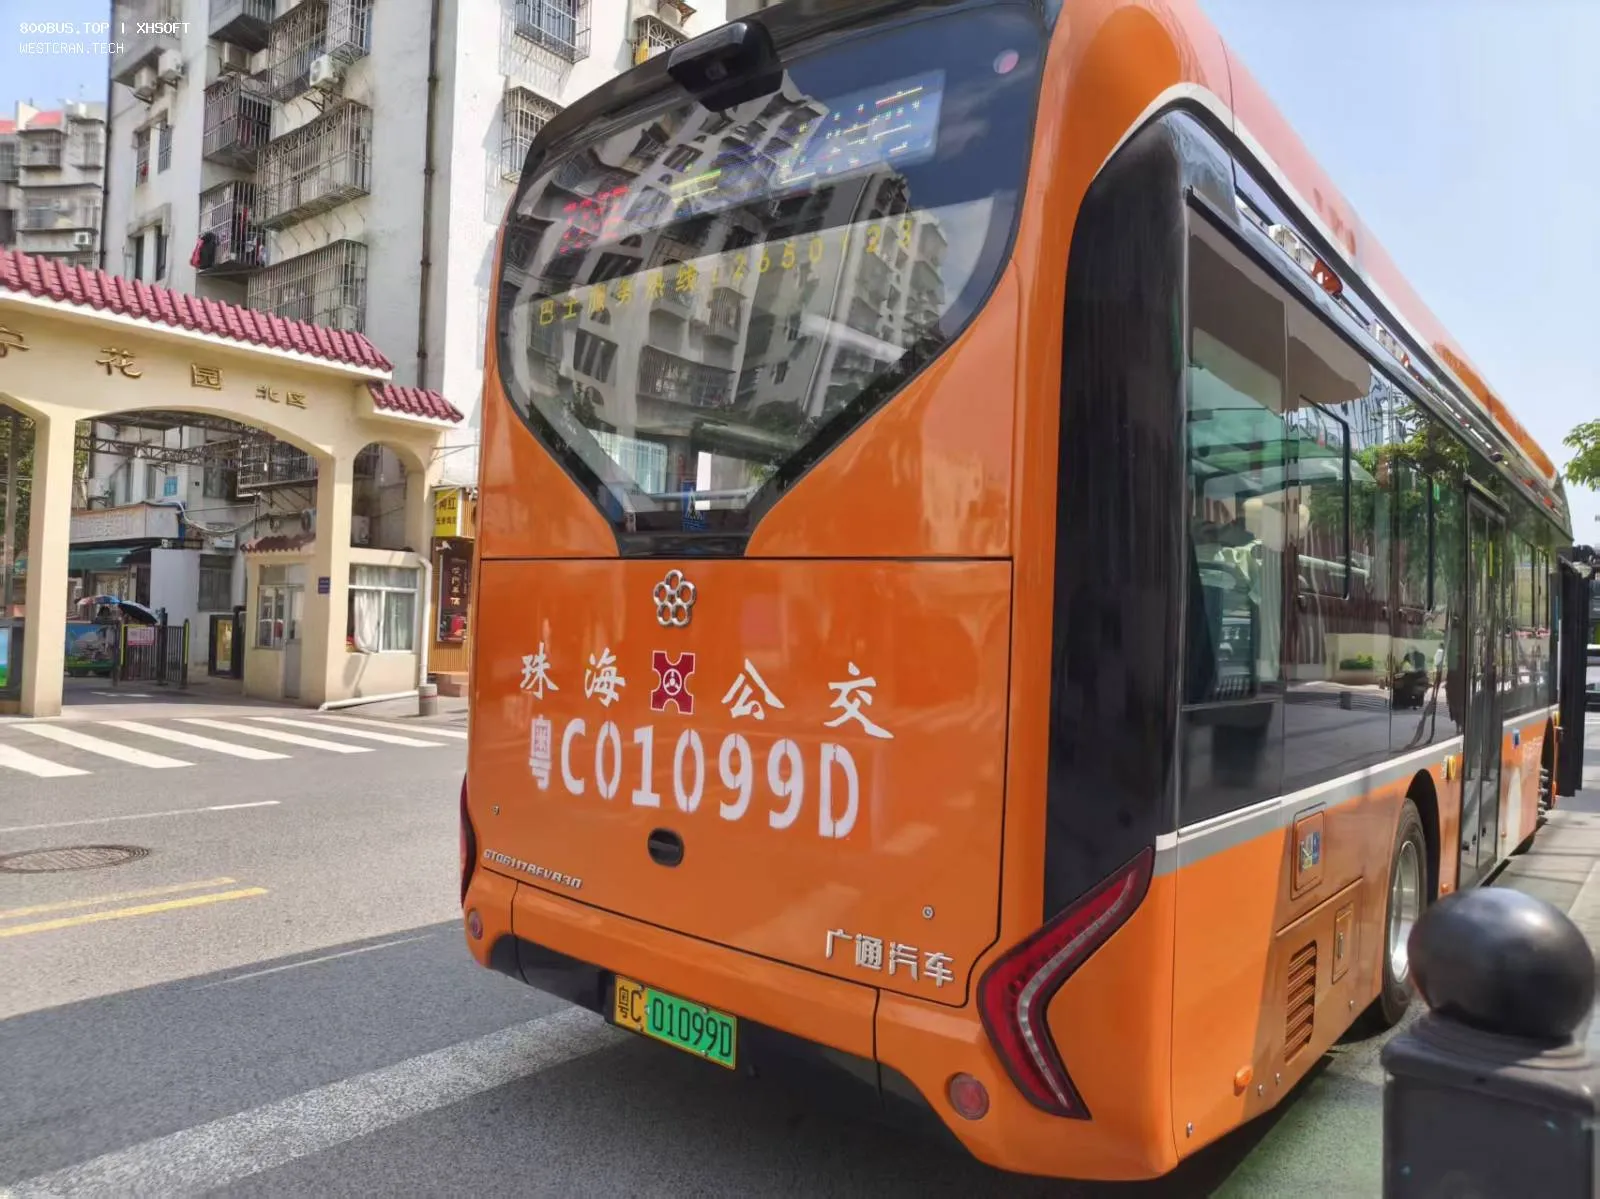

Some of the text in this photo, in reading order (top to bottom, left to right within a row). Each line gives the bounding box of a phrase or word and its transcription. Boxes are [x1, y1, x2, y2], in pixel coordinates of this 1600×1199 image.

[255, 384, 307, 409] 北区
[520, 642, 894, 739] 珠海 公交
[528, 714, 860, 839] 粤C01099D
[826, 928, 954, 987] 广通汽车
